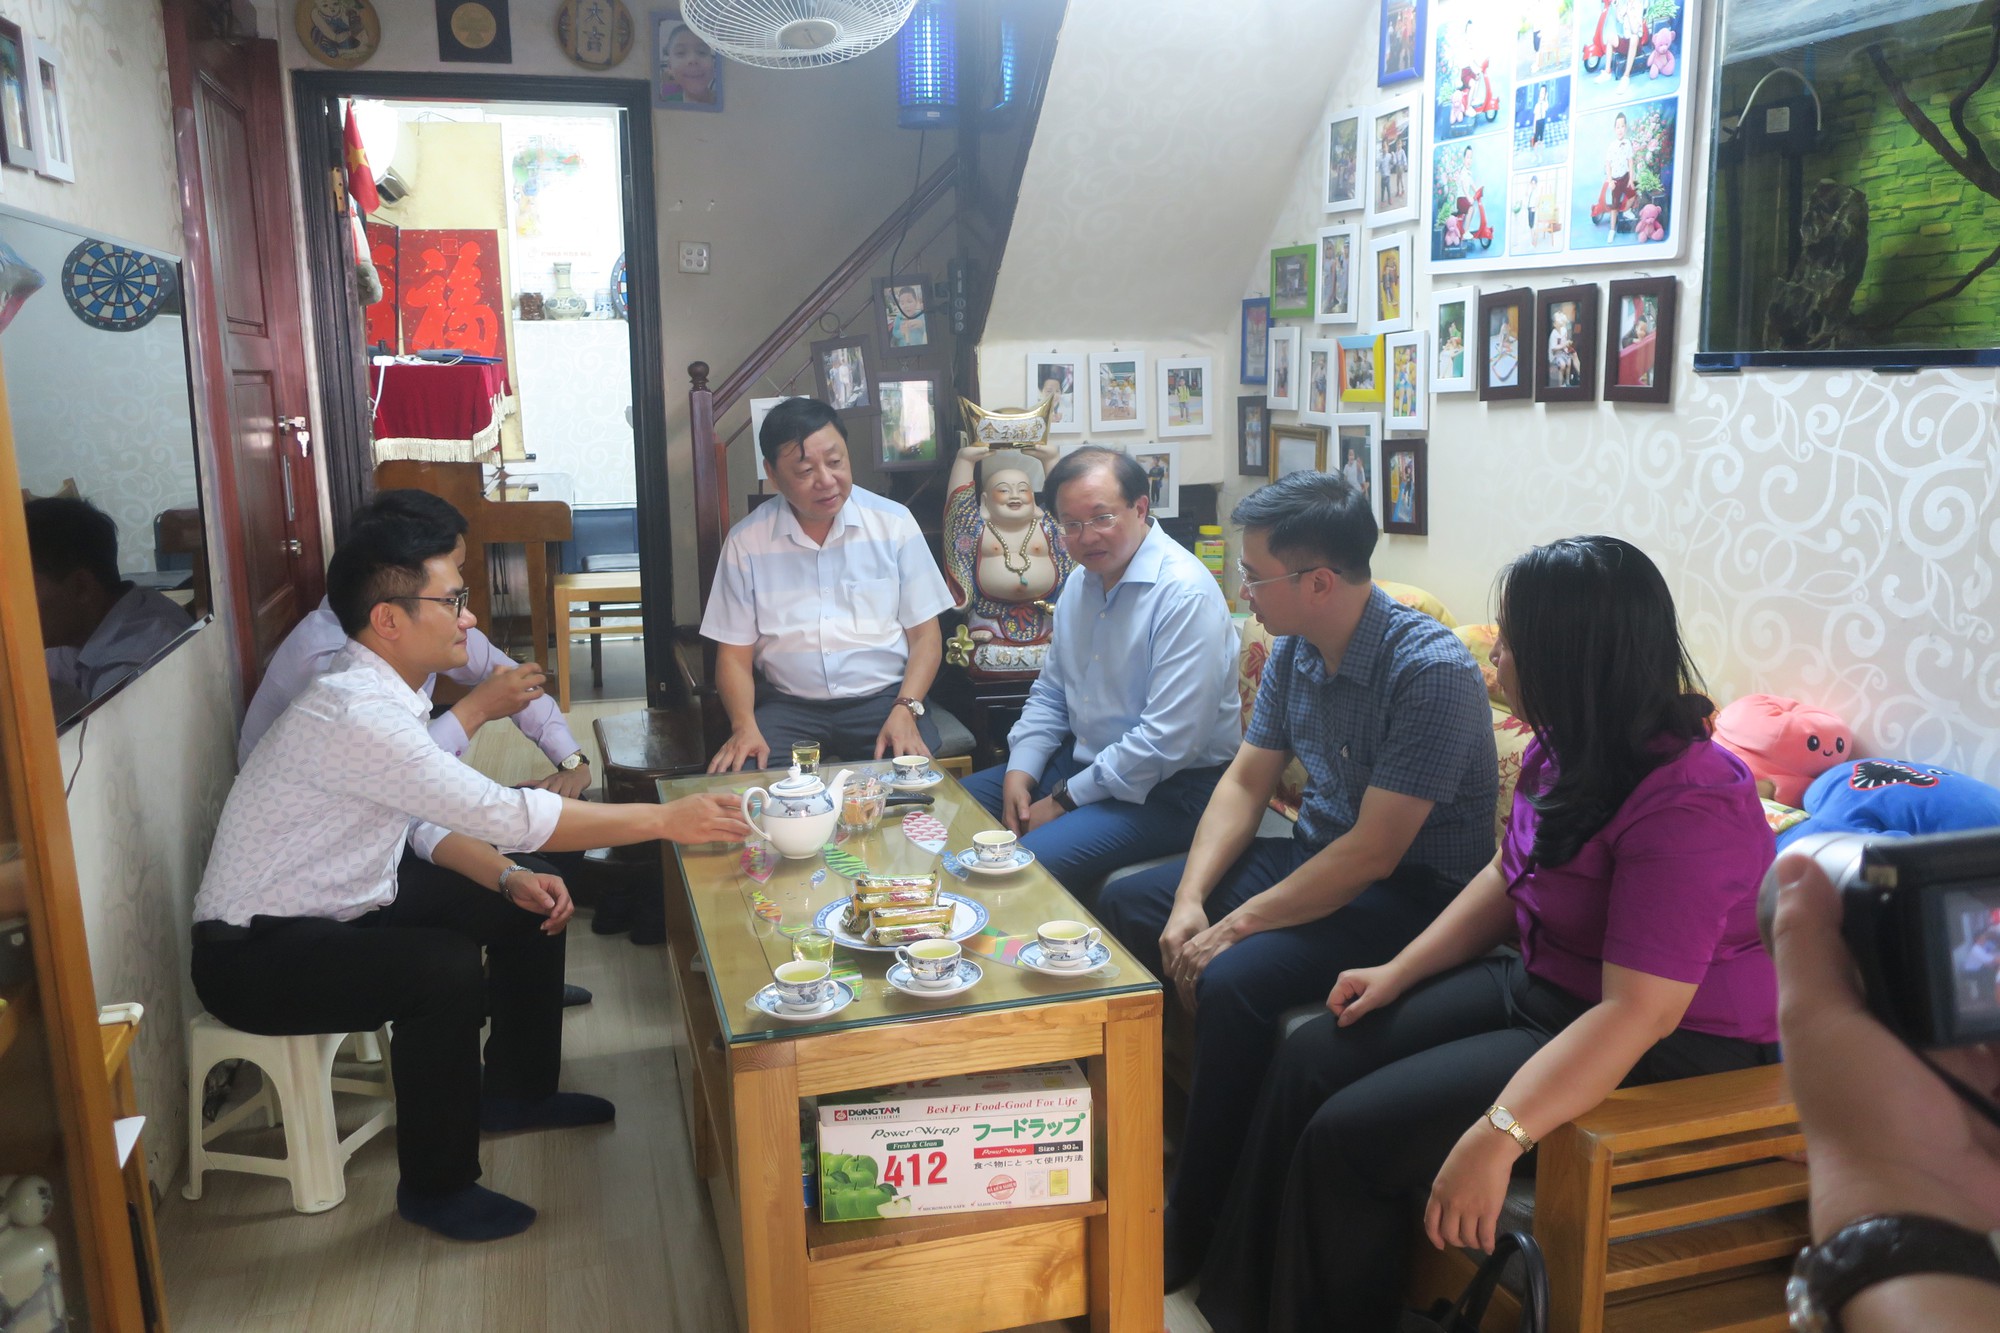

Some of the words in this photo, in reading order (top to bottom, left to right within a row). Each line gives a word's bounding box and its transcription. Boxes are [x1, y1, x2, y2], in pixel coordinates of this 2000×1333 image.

[927, 1105, 949, 1115] Best
[950, 1103, 971, 1114] For
[974, 1099, 1033, 1112] Food-Good
[1036, 1098, 1055, 1108] For
[1058, 1096, 1078, 1107] Life
[871, 1128, 914, 1140] Power
[914, 1126, 960, 1136] Wrap
[973, 1112, 1086, 1141] フードラップ
[893, 1142, 911, 1150] Fresh
[919, 1140, 938, 1148] Clean
[981, 1148, 1004, 1156] Power
[884, 1151, 947, 1187] 412
[974, 1154, 1084, 1170] 食べ物にとって使用方法
